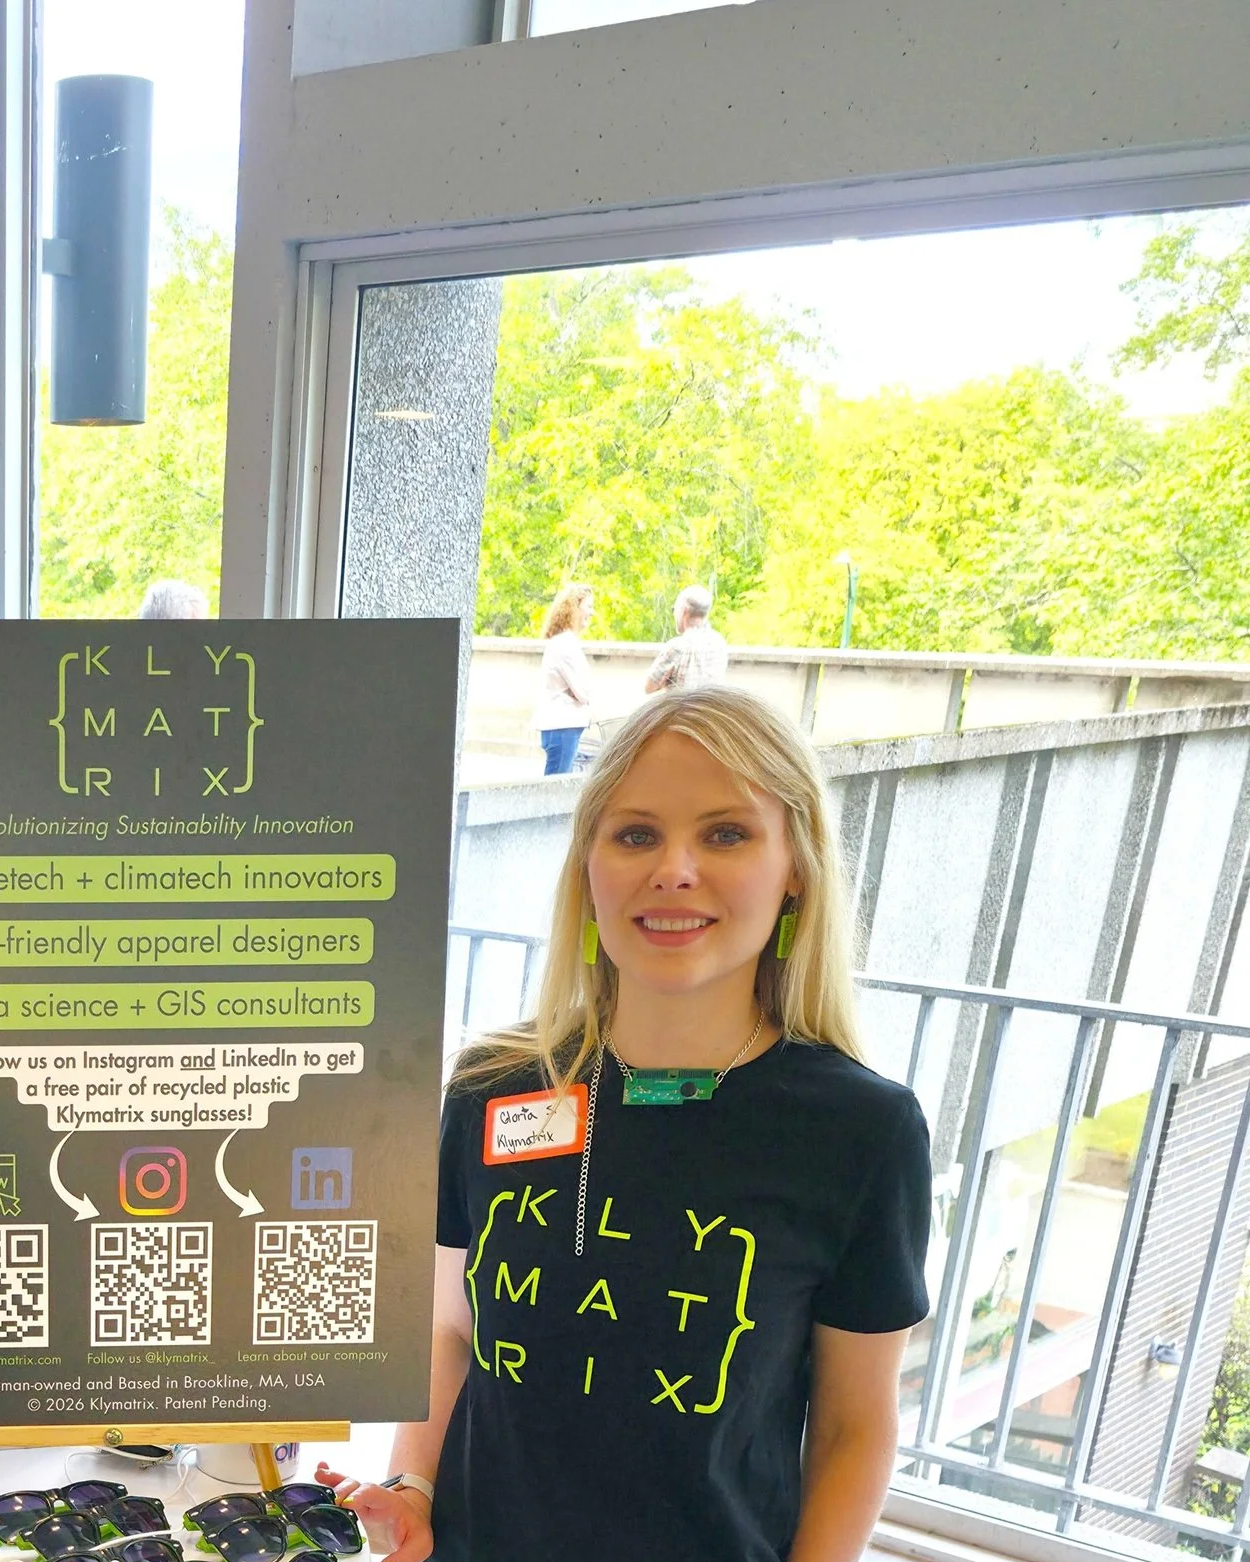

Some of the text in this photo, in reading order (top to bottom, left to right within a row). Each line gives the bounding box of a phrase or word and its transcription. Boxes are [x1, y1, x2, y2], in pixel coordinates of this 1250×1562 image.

[115, 813, 247, 841] Sustainability
[252, 813, 354, 835] Innovation
[76, 871, 94, 889] +
[103, 860, 232, 891] climatech
[243, 863, 383, 890] innovators
[117, 924, 222, 962] apparel
[232, 923, 361, 961] designers
[20, 991, 119, 1018] science
[130, 999, 147, 1016] +
[156, 989, 207, 1017] GIS
[216, 986, 362, 1017] consultants
[27, 1055, 48, 1070] us
[53, 1055, 77, 1070] on
[82, 1050, 174, 1074] Instagram
[180, 1048, 216, 1070] and
[221, 1048, 297, 1068] LinkedIn
[303, 1050, 322, 1067] to
[326, 1050, 356, 1072] get
[26, 1074, 291, 1101] a free pair of recycled plastic
[56, 1102, 253, 1129] Klymatrix sunglasses!
[87, 1352, 125, 1365] Follow
[129, 1354, 141, 1365] us
[237, 1350, 389, 1364] Learn about our company
[86, 1376, 113, 1391] and
[118, 1375, 160, 1390] Based
[166, 1376, 178, 1389] in
[184, 1374, 253, 1391] Brookline,
[258, 1374, 289, 1390] MA,
[294, 1373, 326, 1387] USA
[27, 1395, 271, 1415] © 2026 Klymatrix. Patent Pending.
